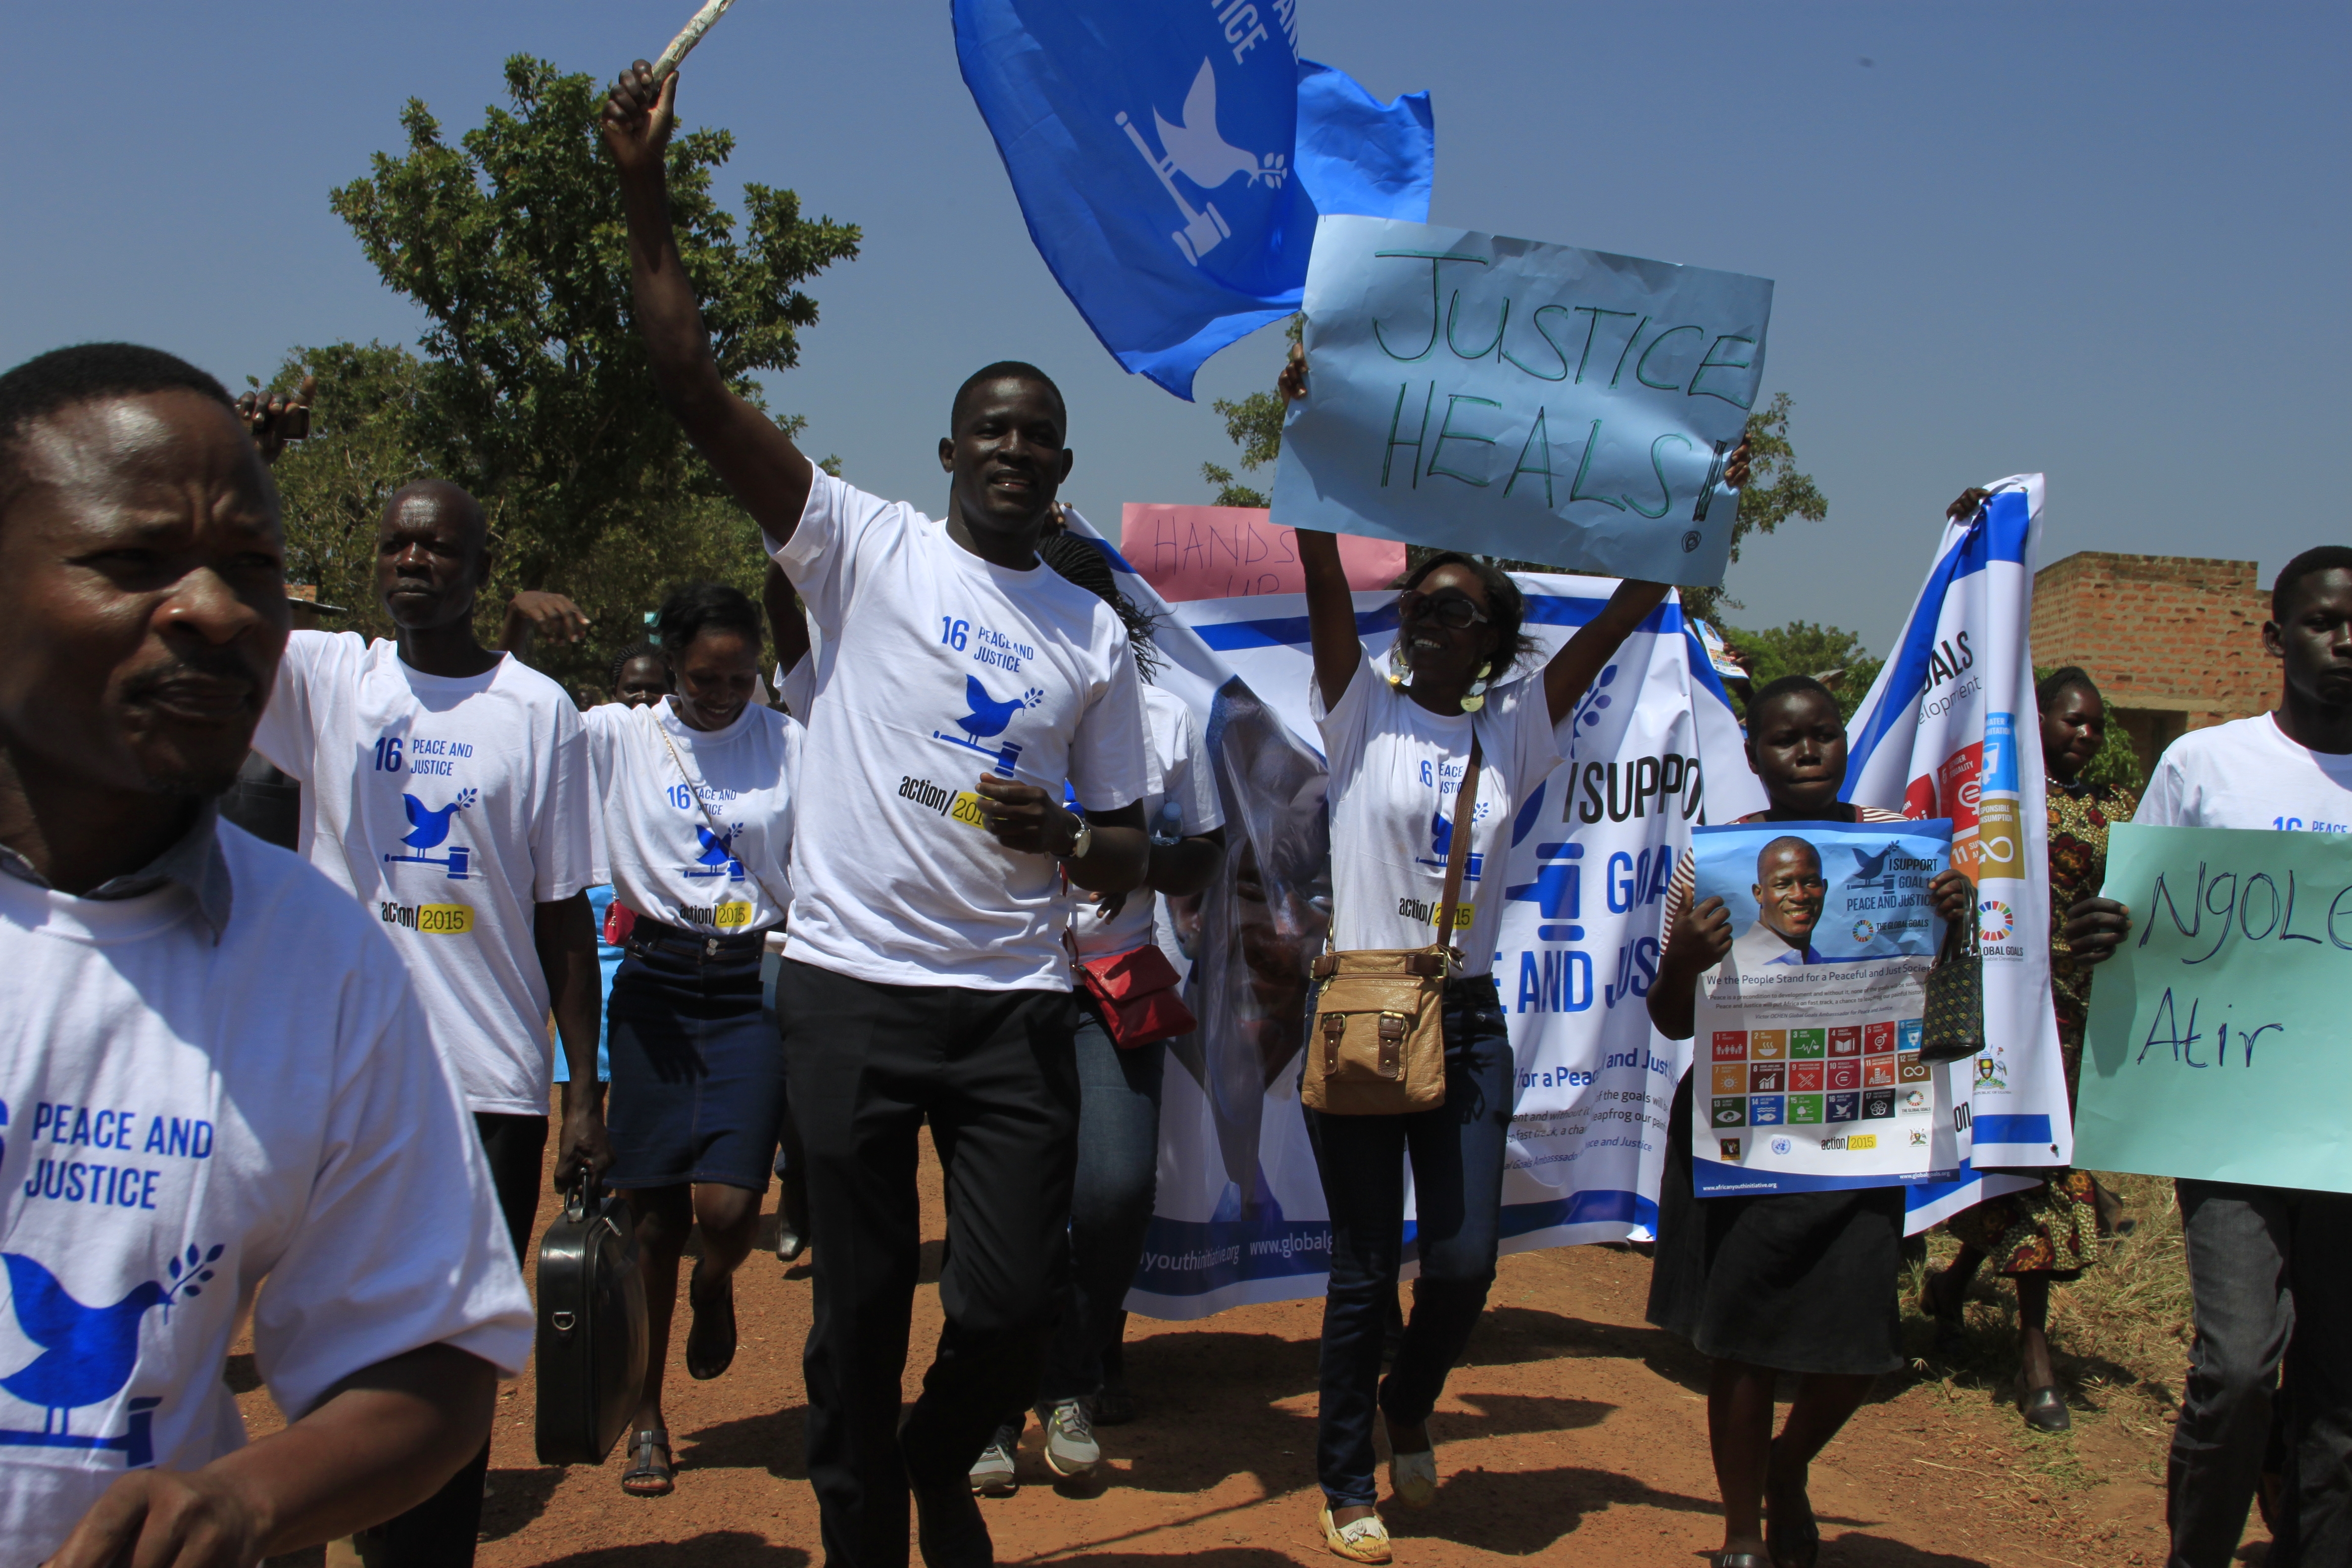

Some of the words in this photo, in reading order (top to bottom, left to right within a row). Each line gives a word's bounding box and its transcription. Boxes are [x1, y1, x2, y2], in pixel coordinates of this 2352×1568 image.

[1372, 249, 1756, 410] JUSTICE
[1381, 379, 1727, 553] HEALS!
[1154, 516, 1296, 576] HANDS
[942, 616, 970, 652] 16
[974, 646, 1022, 673] JUSTICE
[1014, 643, 1034, 661] AND
[375, 737, 403, 772] 16
[413, 739, 447, 755] PEACE
[448, 743, 474, 758] AND
[411, 760, 454, 776] JUSTICE
[1419, 760, 1432, 787] 6
[1439, 763, 1464, 778] EACE
[667, 784, 691, 809] 16
[694, 787, 717, 800] ACE
[719, 789, 737, 801] AND
[899, 775, 984, 826] action/201
[1562, 762, 1579, 823] I
[1579, 753, 1706, 826] SUPPO
[1894, 858, 1938, 872] SUPPORT
[1952, 846, 1969, 864] 11
[1607, 844, 1676, 914] GOA
[1899, 876, 1924, 889] GOAL
[1925, 878, 1930, 888] 1
[1399, 897, 1470, 926] action/215
[1847, 897, 1875, 911] PEACE
[1877, 895, 1897, 909] AND
[1898, 893, 1931, 907] JUSTIC
[1876, 922, 1887, 931] THE
[1888, 920, 1907, 930] GLOBAL
[1909, 919, 1929, 927] GOALS
[2006, 946, 2023, 956] GOALS
[1518, 950, 1593, 1014] AND
[1605, 936, 1660, 1009] JUS
[1707, 976, 1721, 984] We
[1724, 976, 1739, 984] the
[1742, 975, 1774, 986] People
[1776, 974, 1804, 984] Stand
[1806, 973, 1819, 982] for
[1829, 970, 1866, 981] Peaceful
[1868, 969, 1884, 978] and
[1885, 966, 1901, 976] Just
[1903, 964, 1931, 973] Societ
[2137, 986, 2284, 1068] Atir
[1517, 1067, 1538, 1088] for
[1543, 1072, 1552, 1087] a
[1607, 1048, 1638, 1069] and
[1641, 1049, 1668, 1078] Just
[1512, 1112, 1528, 1123] ent
[1530, 1110, 1549, 1122] and
[1550, 1109, 1581, 1121] without
[1604, 1089, 1619, 1101] the
[1621, 1090, 1651, 1103] goals
[32, 1101, 136, 1151] PEACE
[145, 1116, 213, 1159] AND
[1517, 1129, 1533, 1141] fast
[1635, 1112, 1652, 1123] our
[1534, 1151, 1578, 1166] Ambasssado
[1601, 1136, 1619, 1146] and
[1620, 1136, 1652, 1152] Justice
[1821, 1135, 1874, 1151] action/2015
[25, 1159, 161, 1209] JUSTICE
[1703, 1182, 1777, 1191] www.africanyouthinitiative.org
[1140, 1245, 1240, 1272] youthinitiative.org
